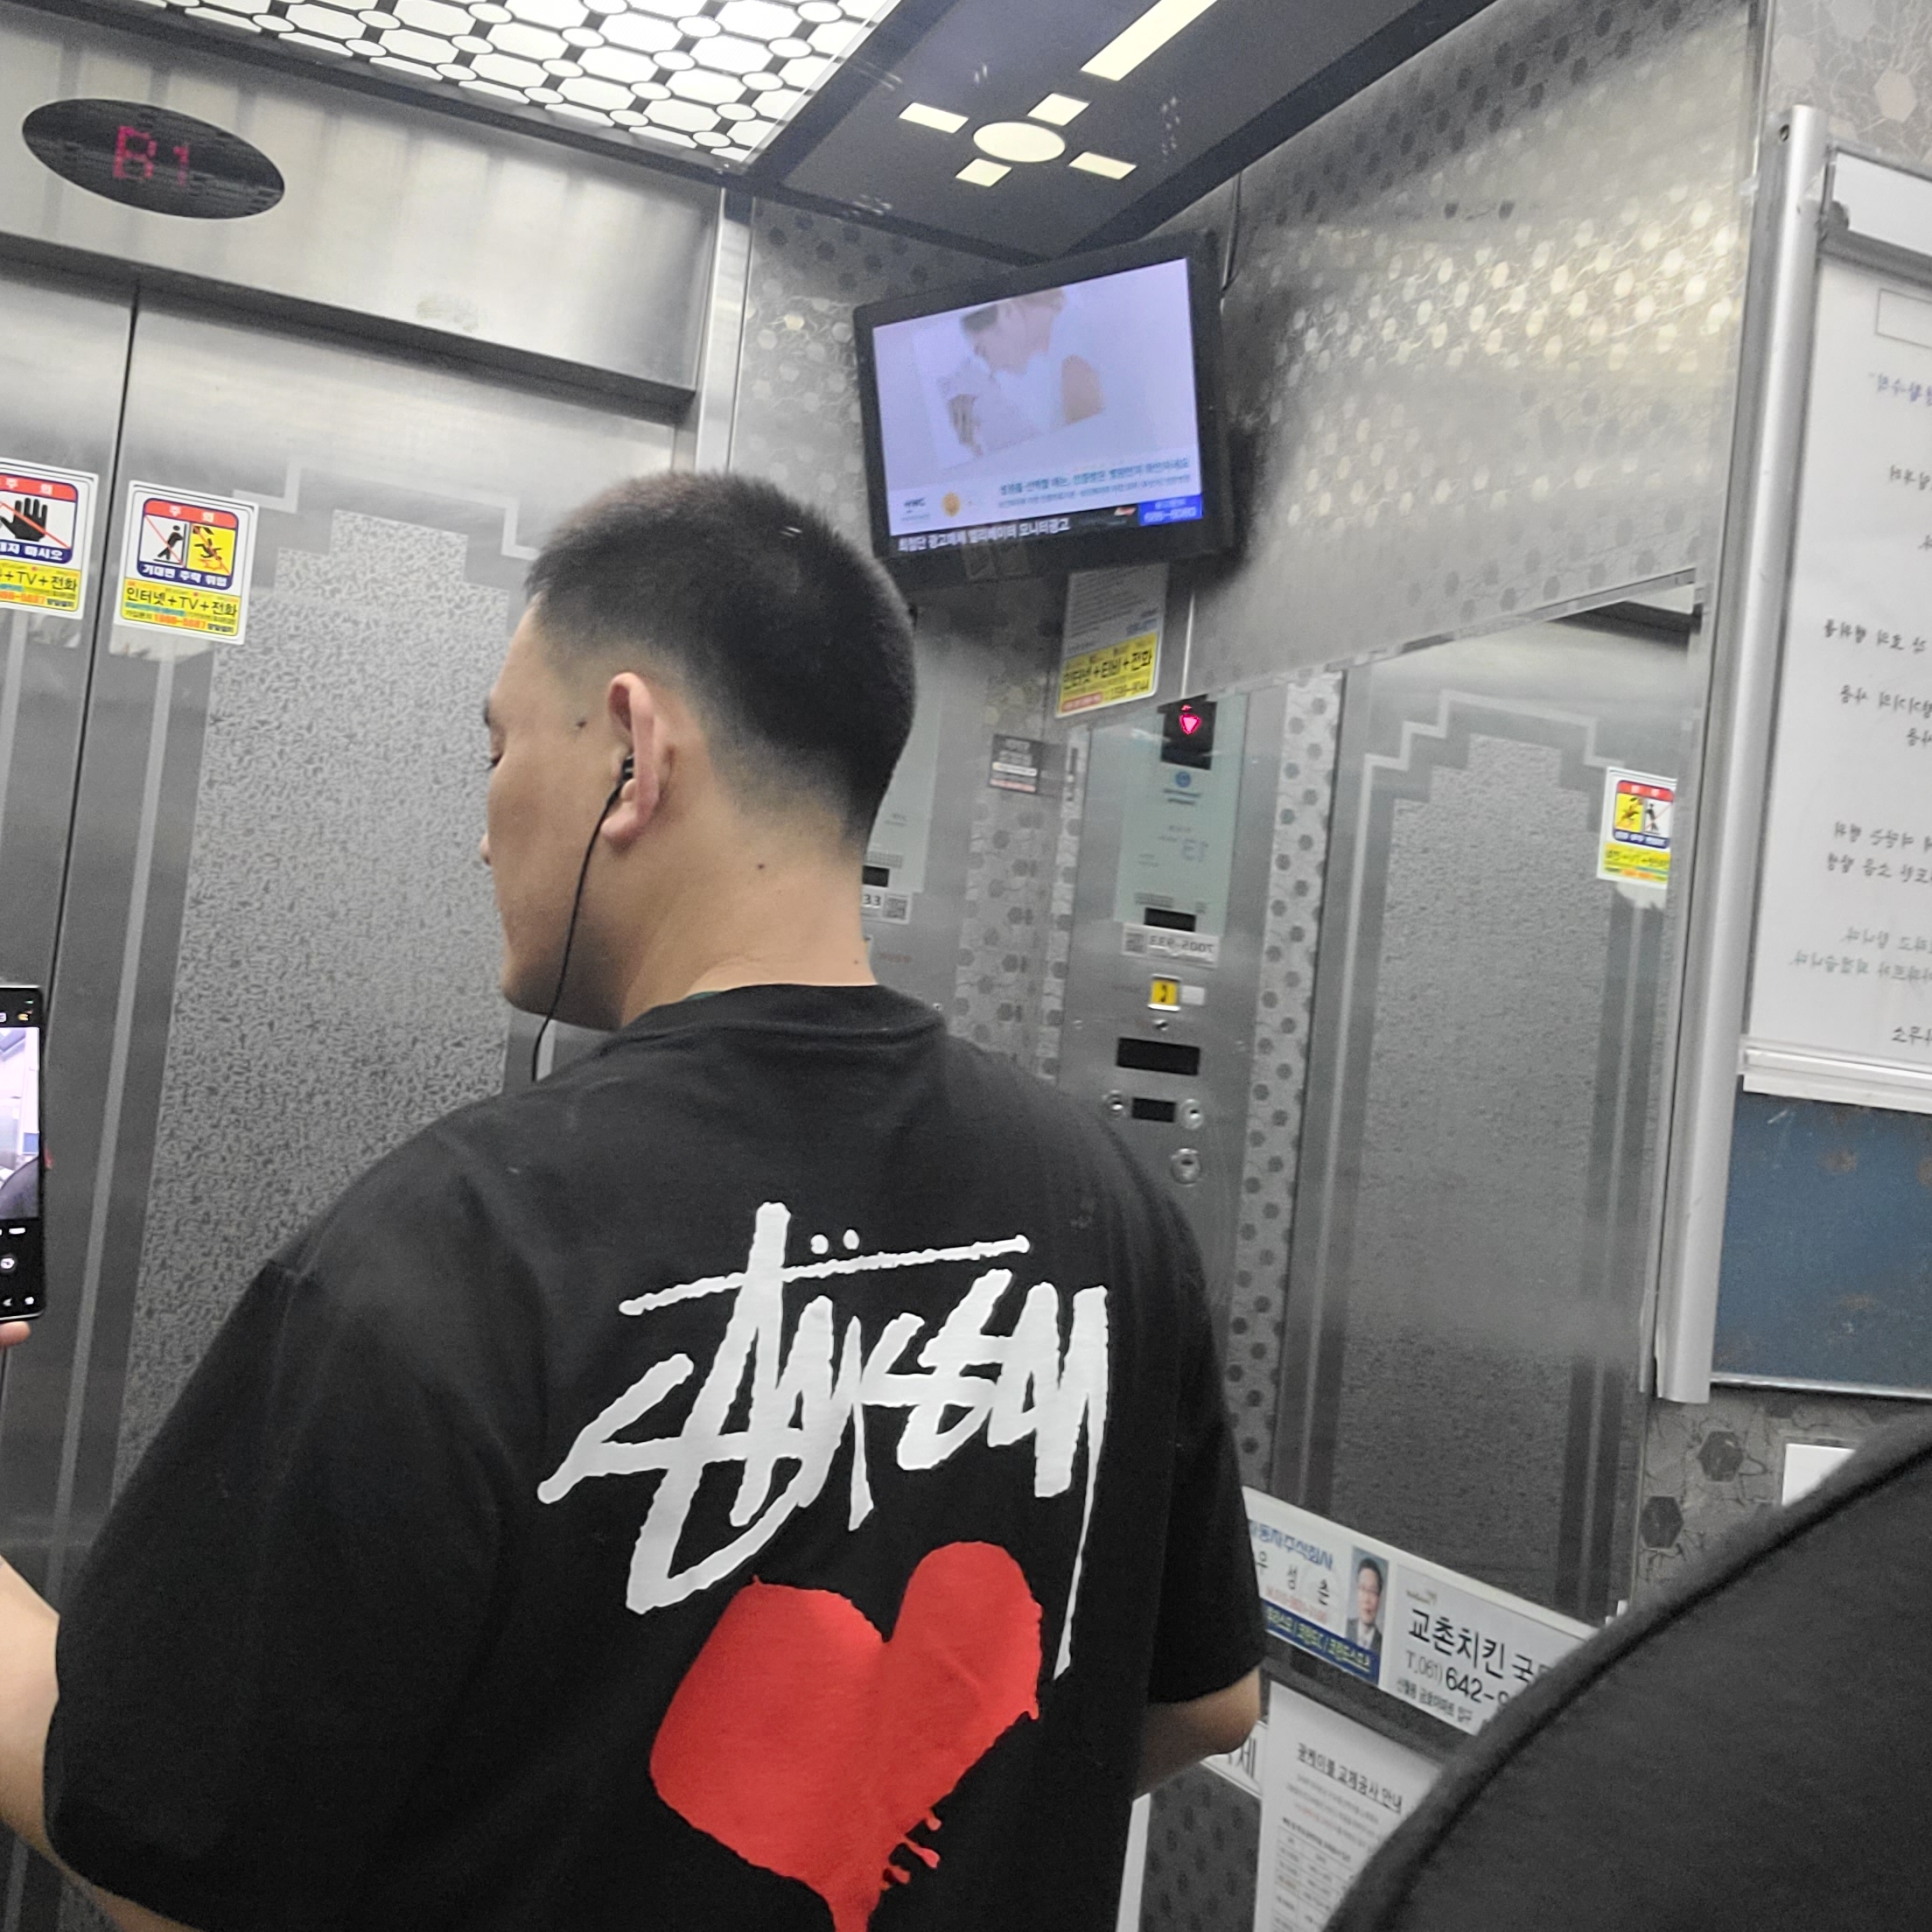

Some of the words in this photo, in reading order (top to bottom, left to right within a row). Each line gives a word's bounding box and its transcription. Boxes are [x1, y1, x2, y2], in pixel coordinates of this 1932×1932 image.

[113, 126, 190, 186] B1
[24, 545, 63, 561] 마시오
[142, 563, 177, 578] 기대면
[178, 568, 201, 583] 추락
[205, 573, 228, 587] 위험
[1409, 1606, 1506, 1679] 교촌치킨
[1511, 1650, 1554, 1686] 국
